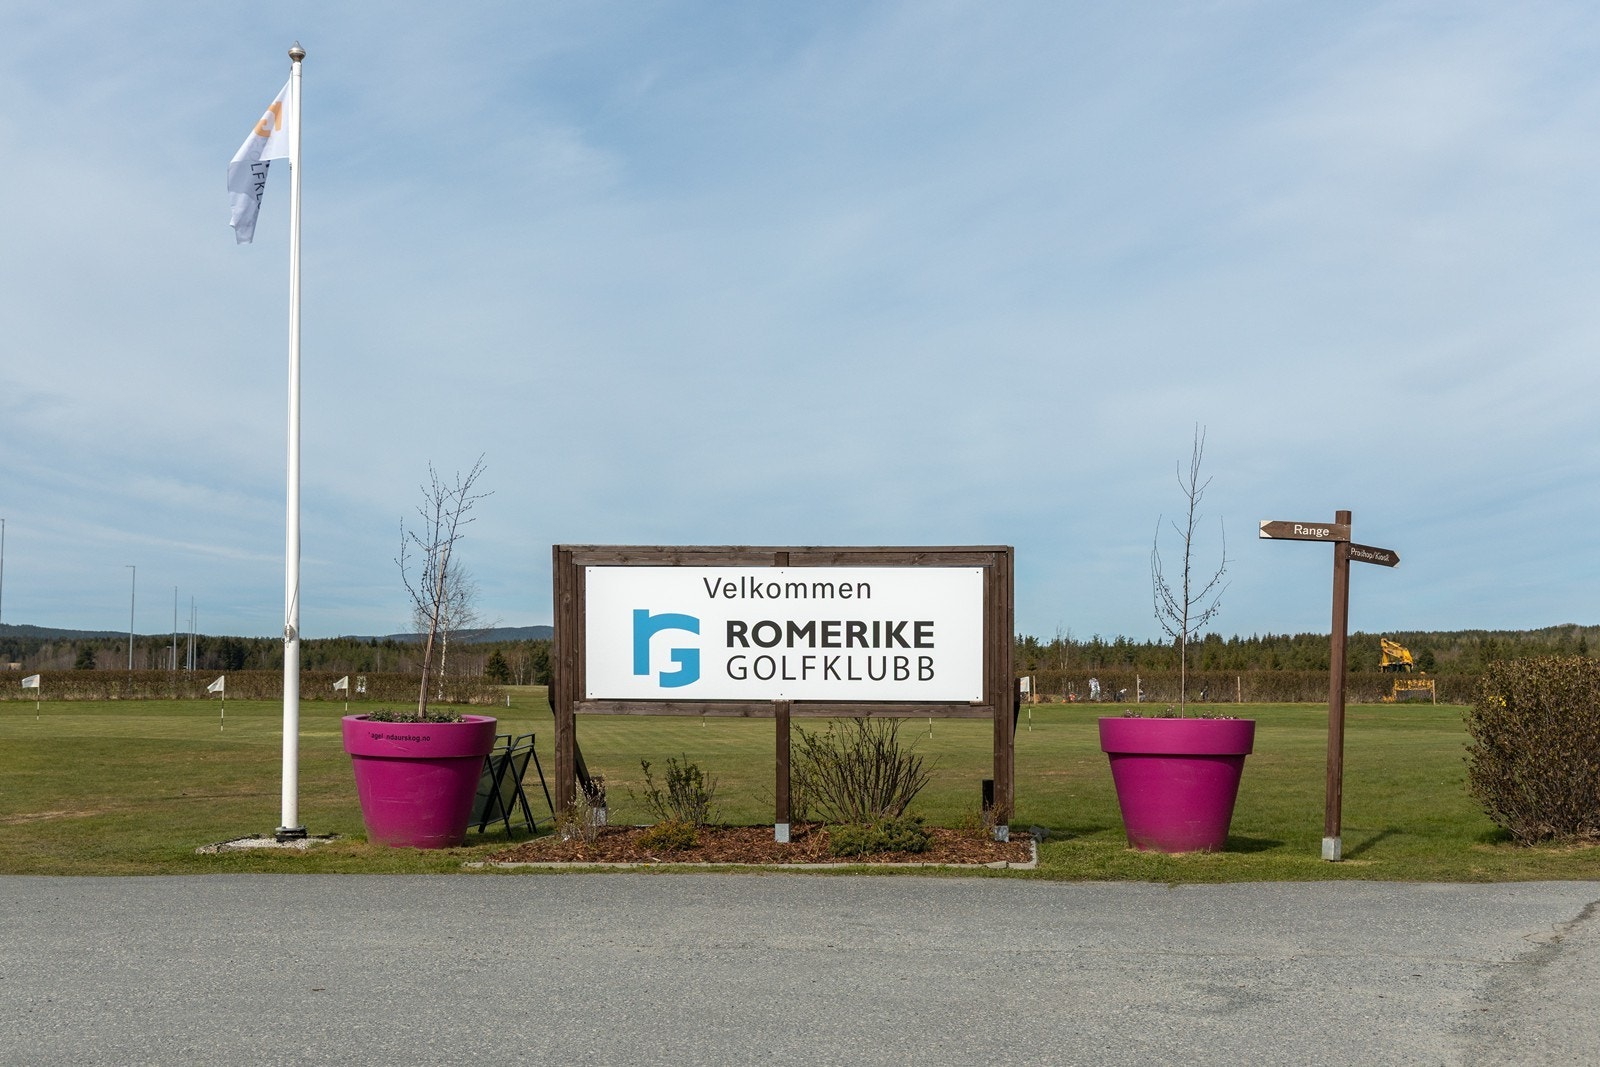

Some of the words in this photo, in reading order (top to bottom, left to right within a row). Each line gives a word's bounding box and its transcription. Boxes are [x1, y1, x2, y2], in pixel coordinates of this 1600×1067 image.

[1294, 524, 1330, 538] Range
[703, 577, 870, 599] Velkommen
[727, 621, 934, 648] ROMERIKE
[727, 655, 934, 681] GOLFKLUBB
